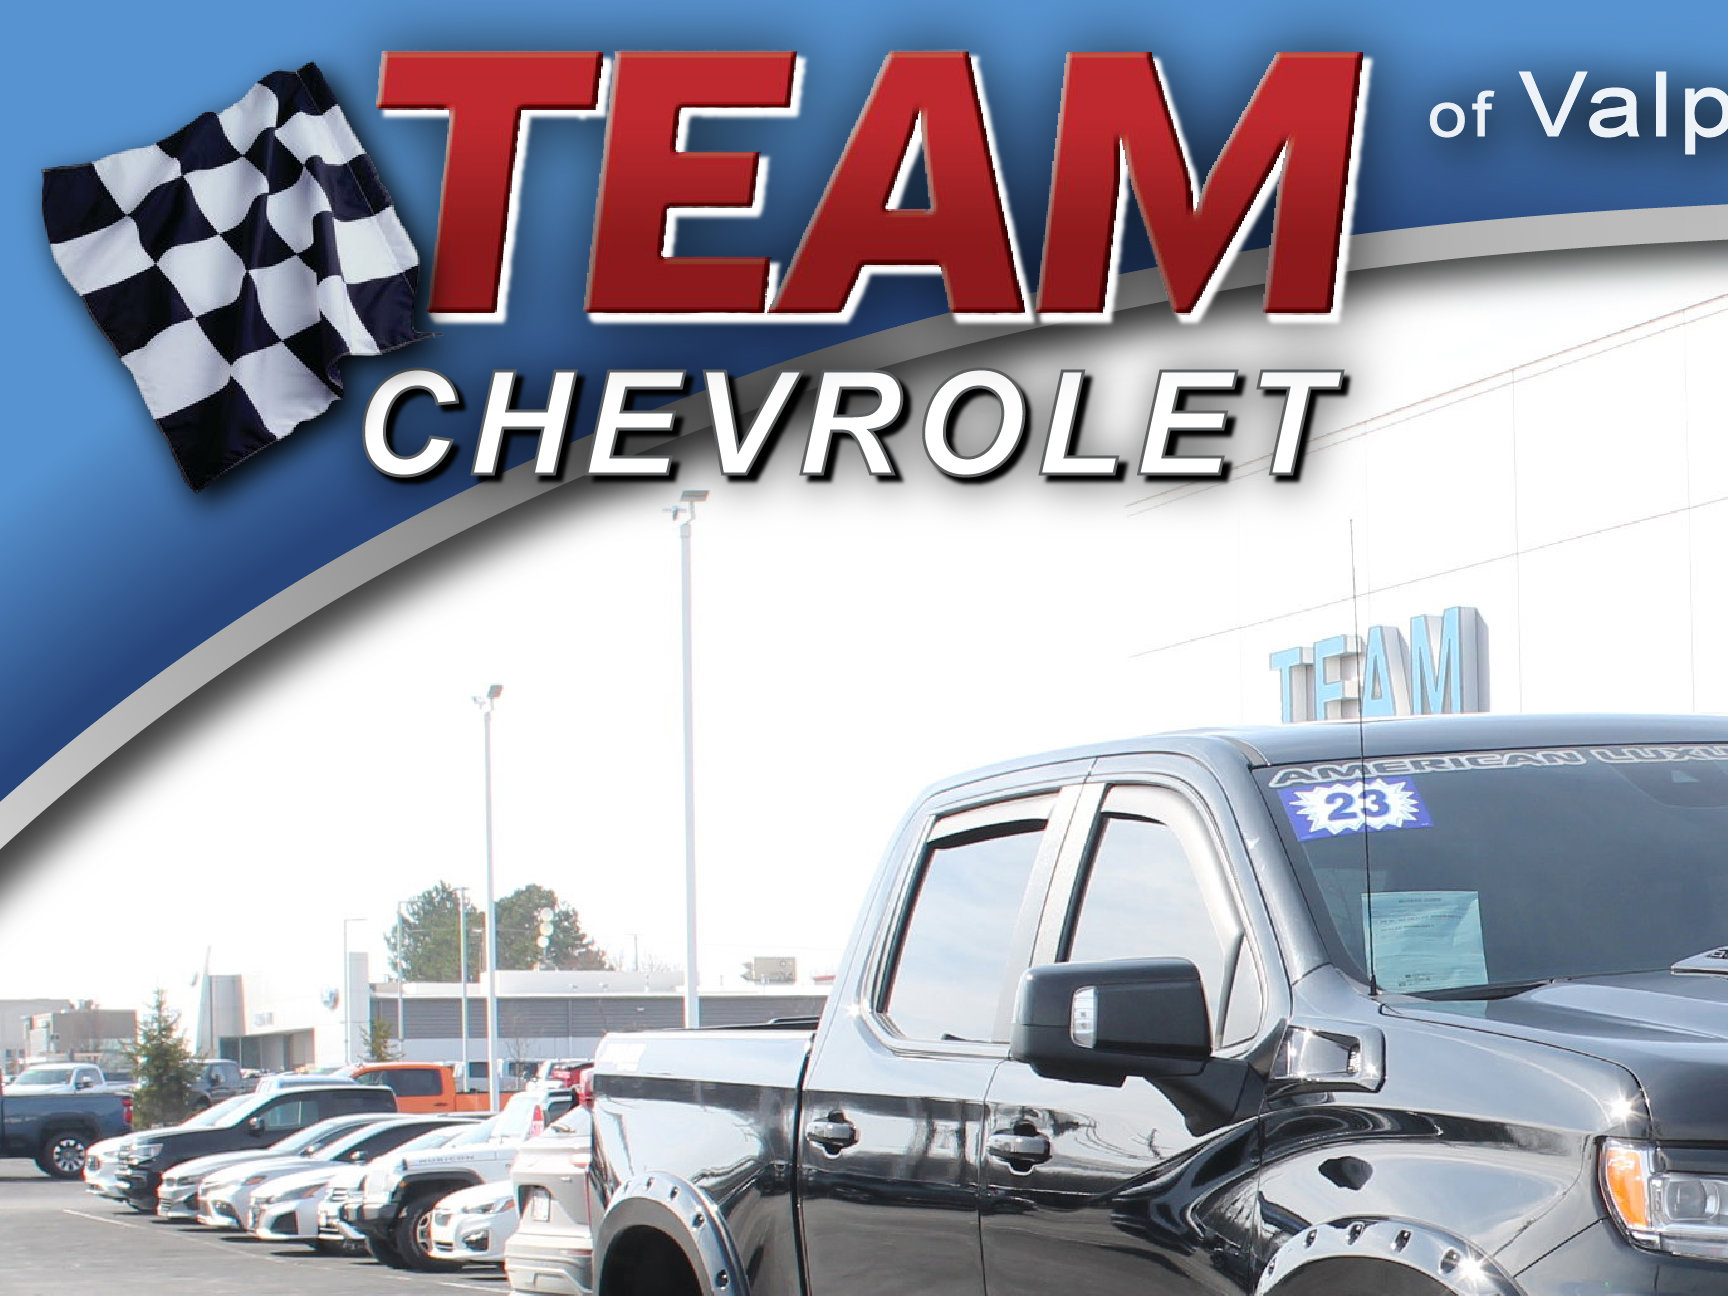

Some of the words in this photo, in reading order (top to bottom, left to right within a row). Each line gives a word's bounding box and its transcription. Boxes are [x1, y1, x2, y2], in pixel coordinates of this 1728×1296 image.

[1268, 606, 1489, 724] TEAM
[1268, 750, 1587, 788] AMERICAN
[1323, 787, 1392, 822] 23
